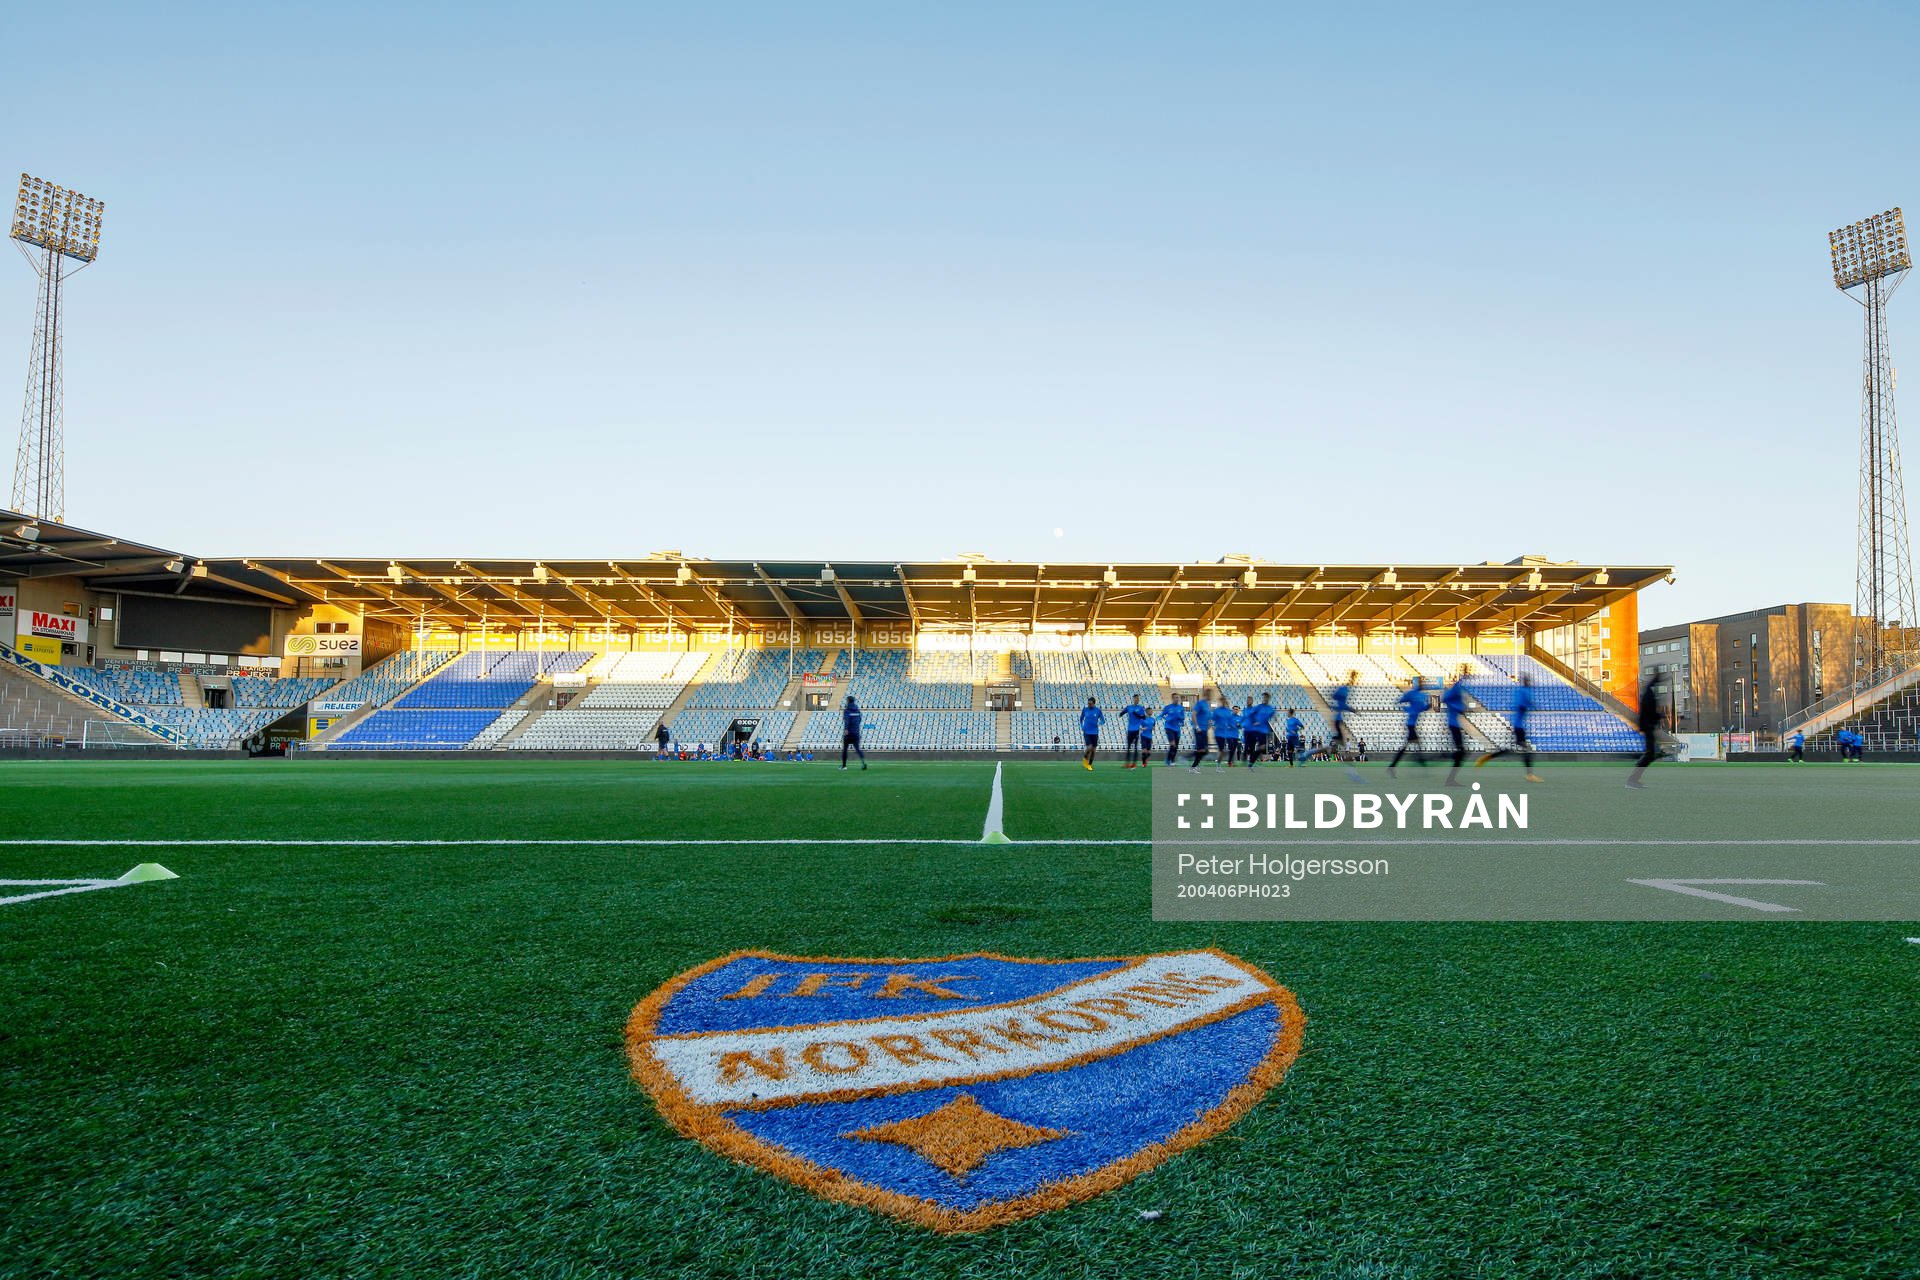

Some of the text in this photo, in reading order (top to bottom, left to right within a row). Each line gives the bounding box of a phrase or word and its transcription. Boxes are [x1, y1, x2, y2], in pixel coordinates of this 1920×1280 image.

[32, 611, 76, 632] MAXI
[758, 630, 801, 644] 1948
[814, 630, 857, 644] 1952
[870, 630, 913, 644] 1956
[722, 973, 981, 1000] IFK
